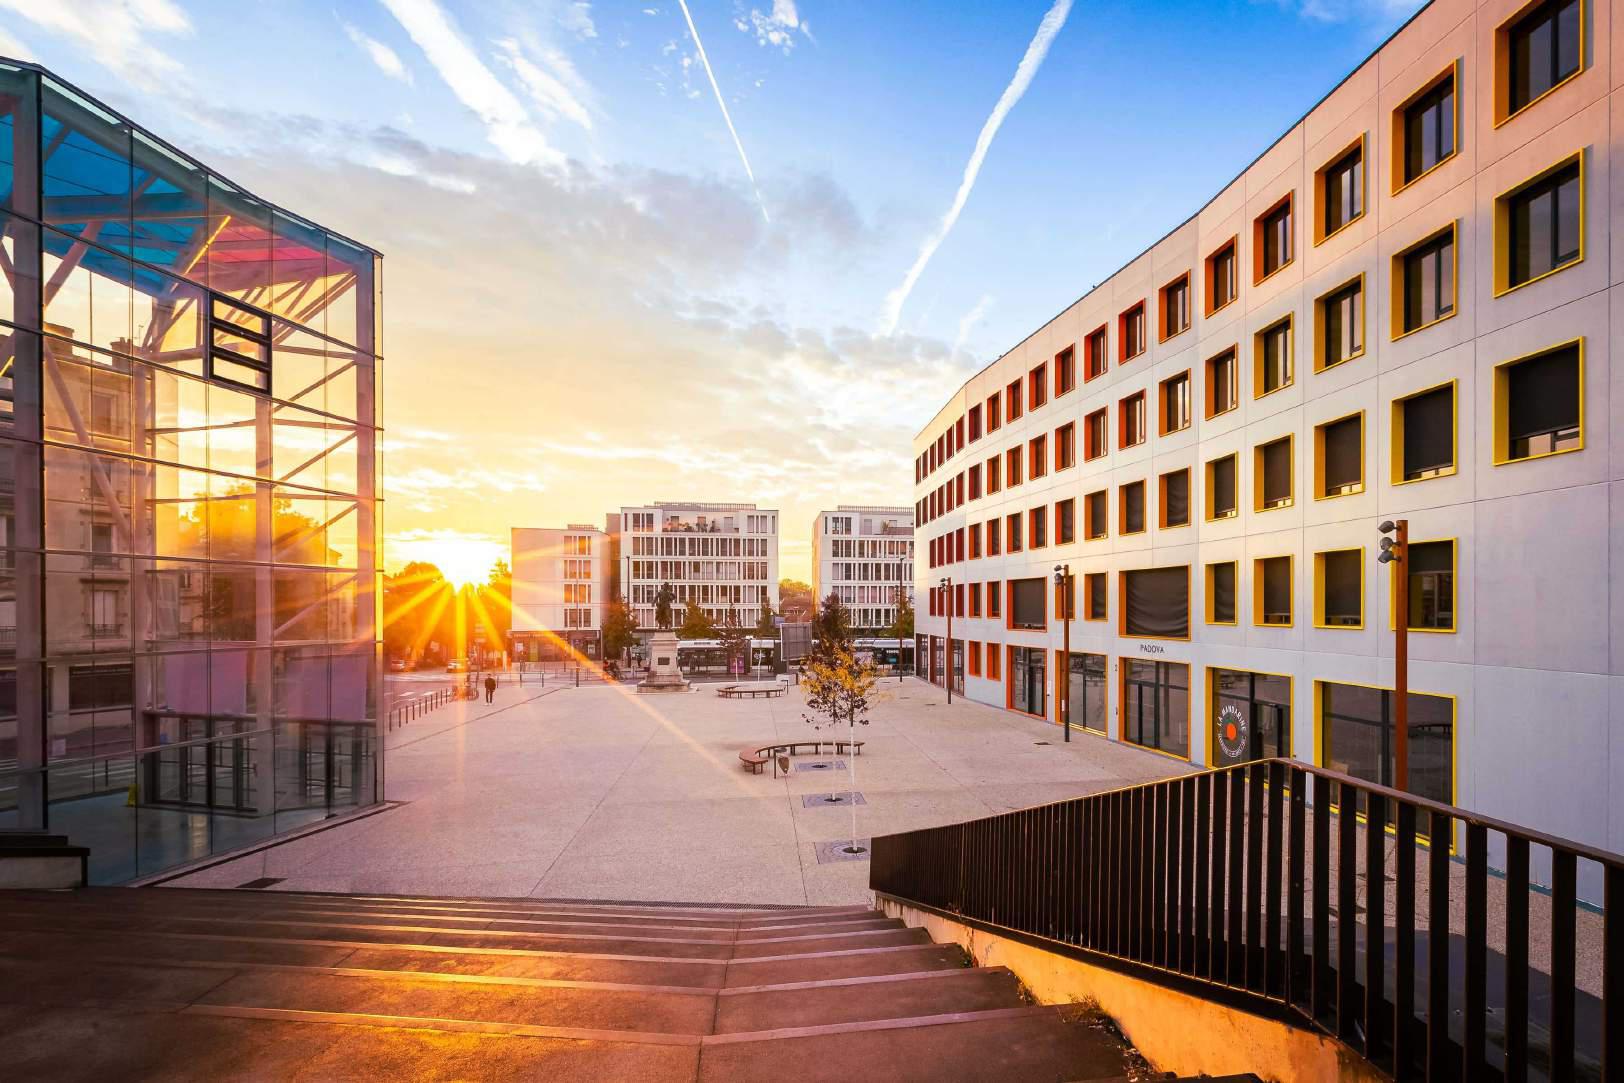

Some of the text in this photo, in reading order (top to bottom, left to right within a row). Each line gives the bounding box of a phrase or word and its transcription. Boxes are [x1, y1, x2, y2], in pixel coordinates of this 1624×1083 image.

[1139, 644, 1165, 654] PADOVA
[1217, 705, 1247, 731] LA MANDARINE
